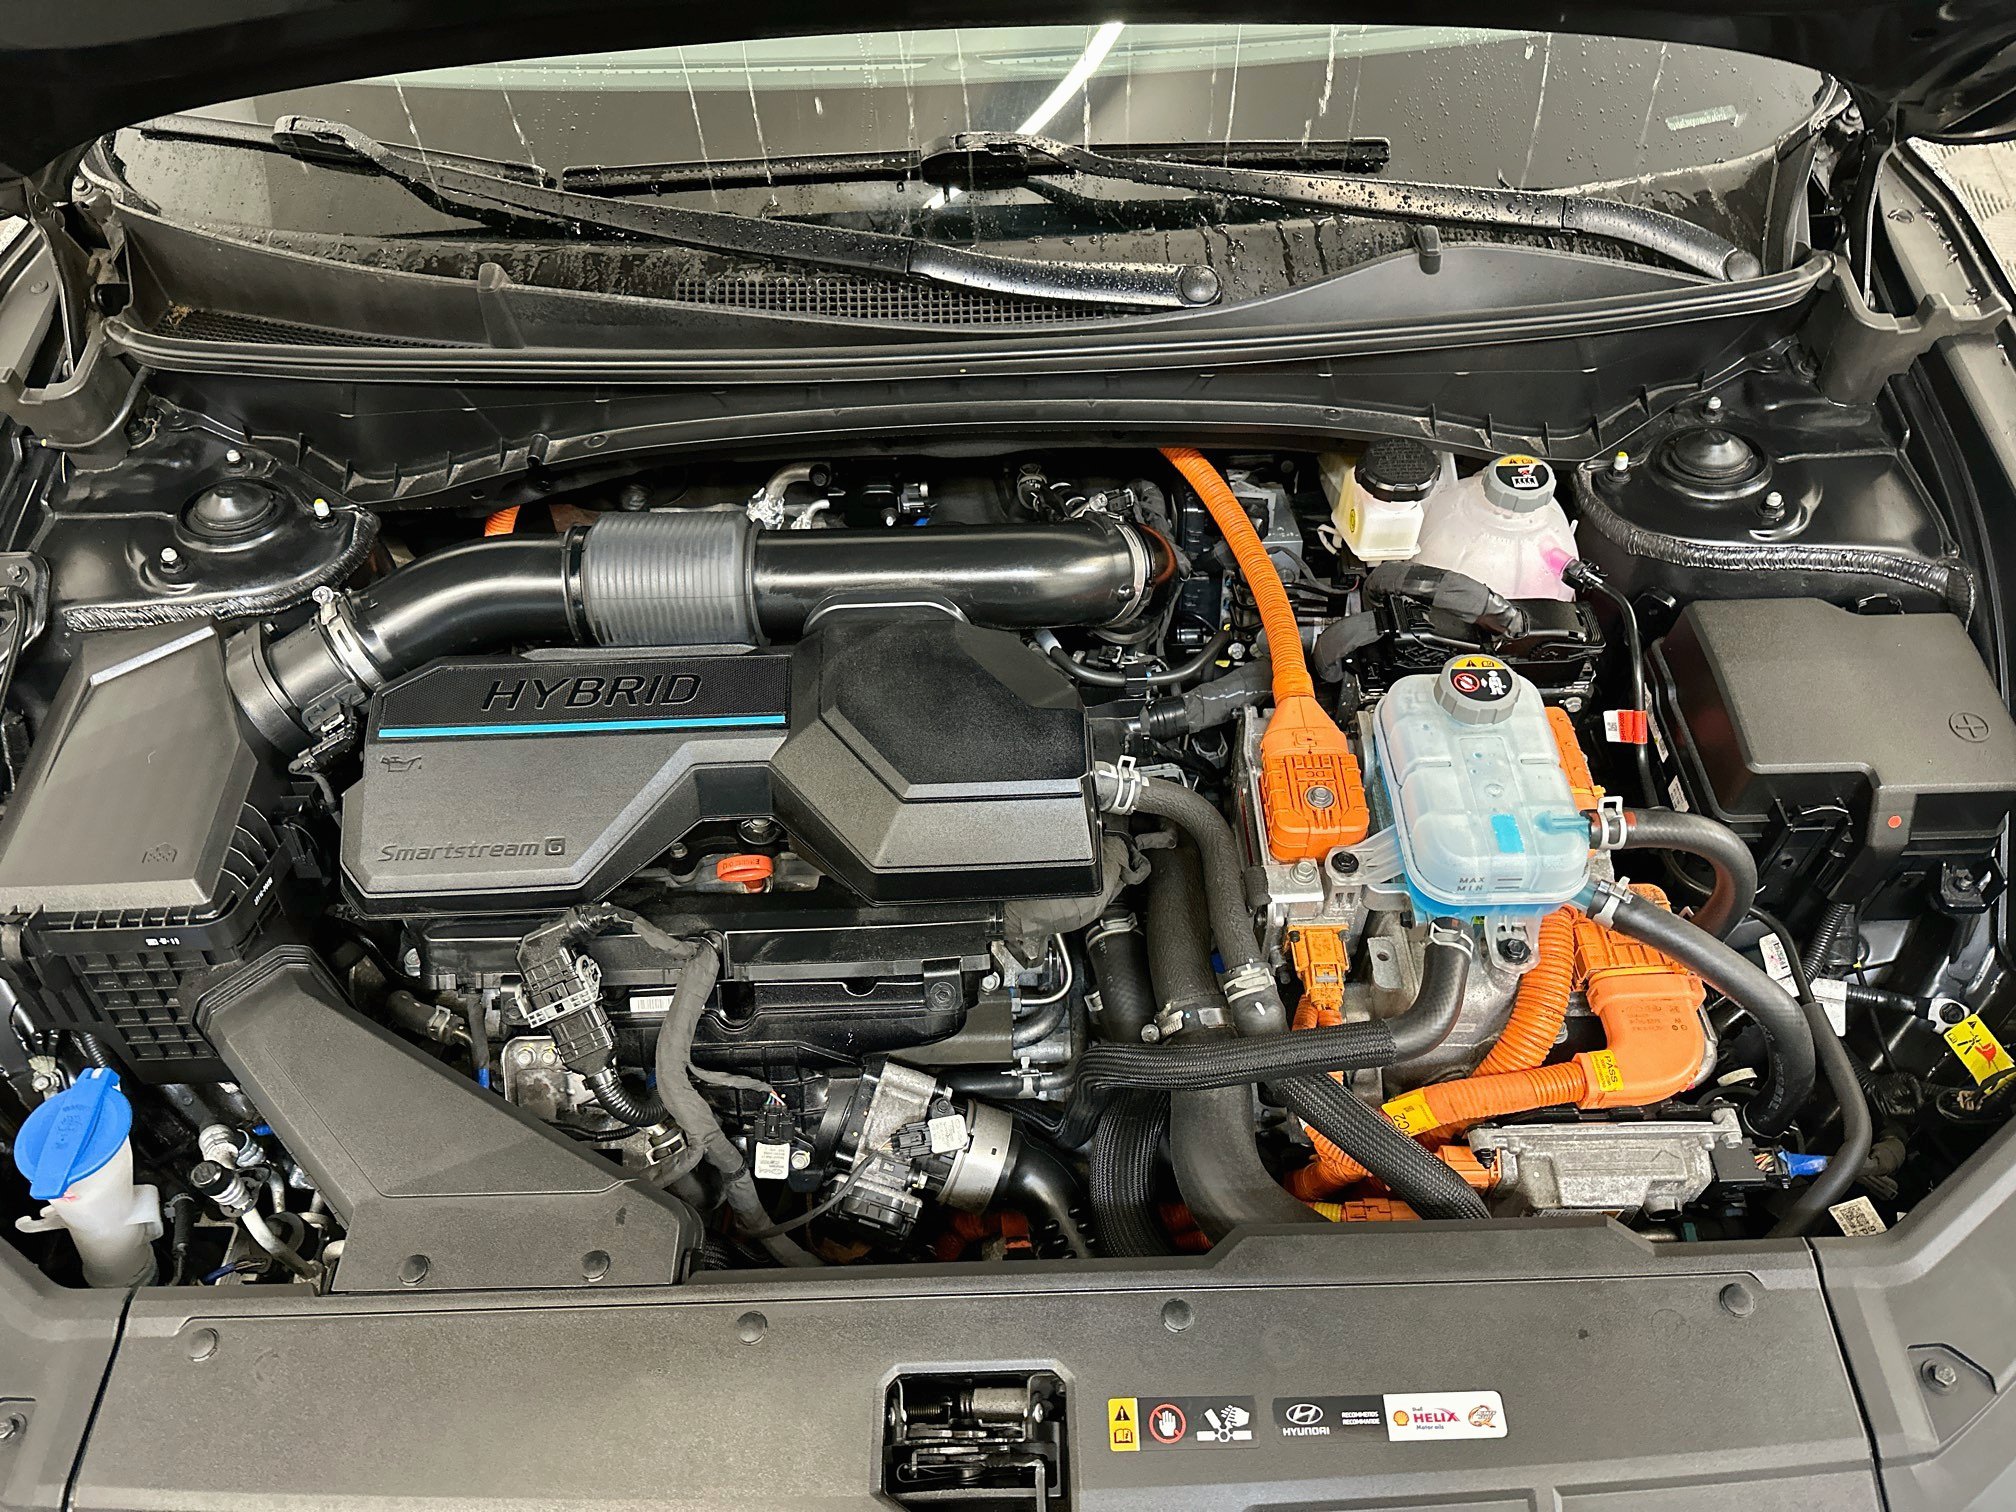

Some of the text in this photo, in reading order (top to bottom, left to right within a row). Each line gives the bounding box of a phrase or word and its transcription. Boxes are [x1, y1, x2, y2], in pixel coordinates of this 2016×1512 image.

[481, 673, 702, 711] HYBRID
[377, 837, 566, 863] Smartstream G
[1603, 1055, 1619, 1083] PASS
[1413, 1411, 1460, 1423] HELIX
[1282, 1426, 1331, 1437] HYUNDAI
